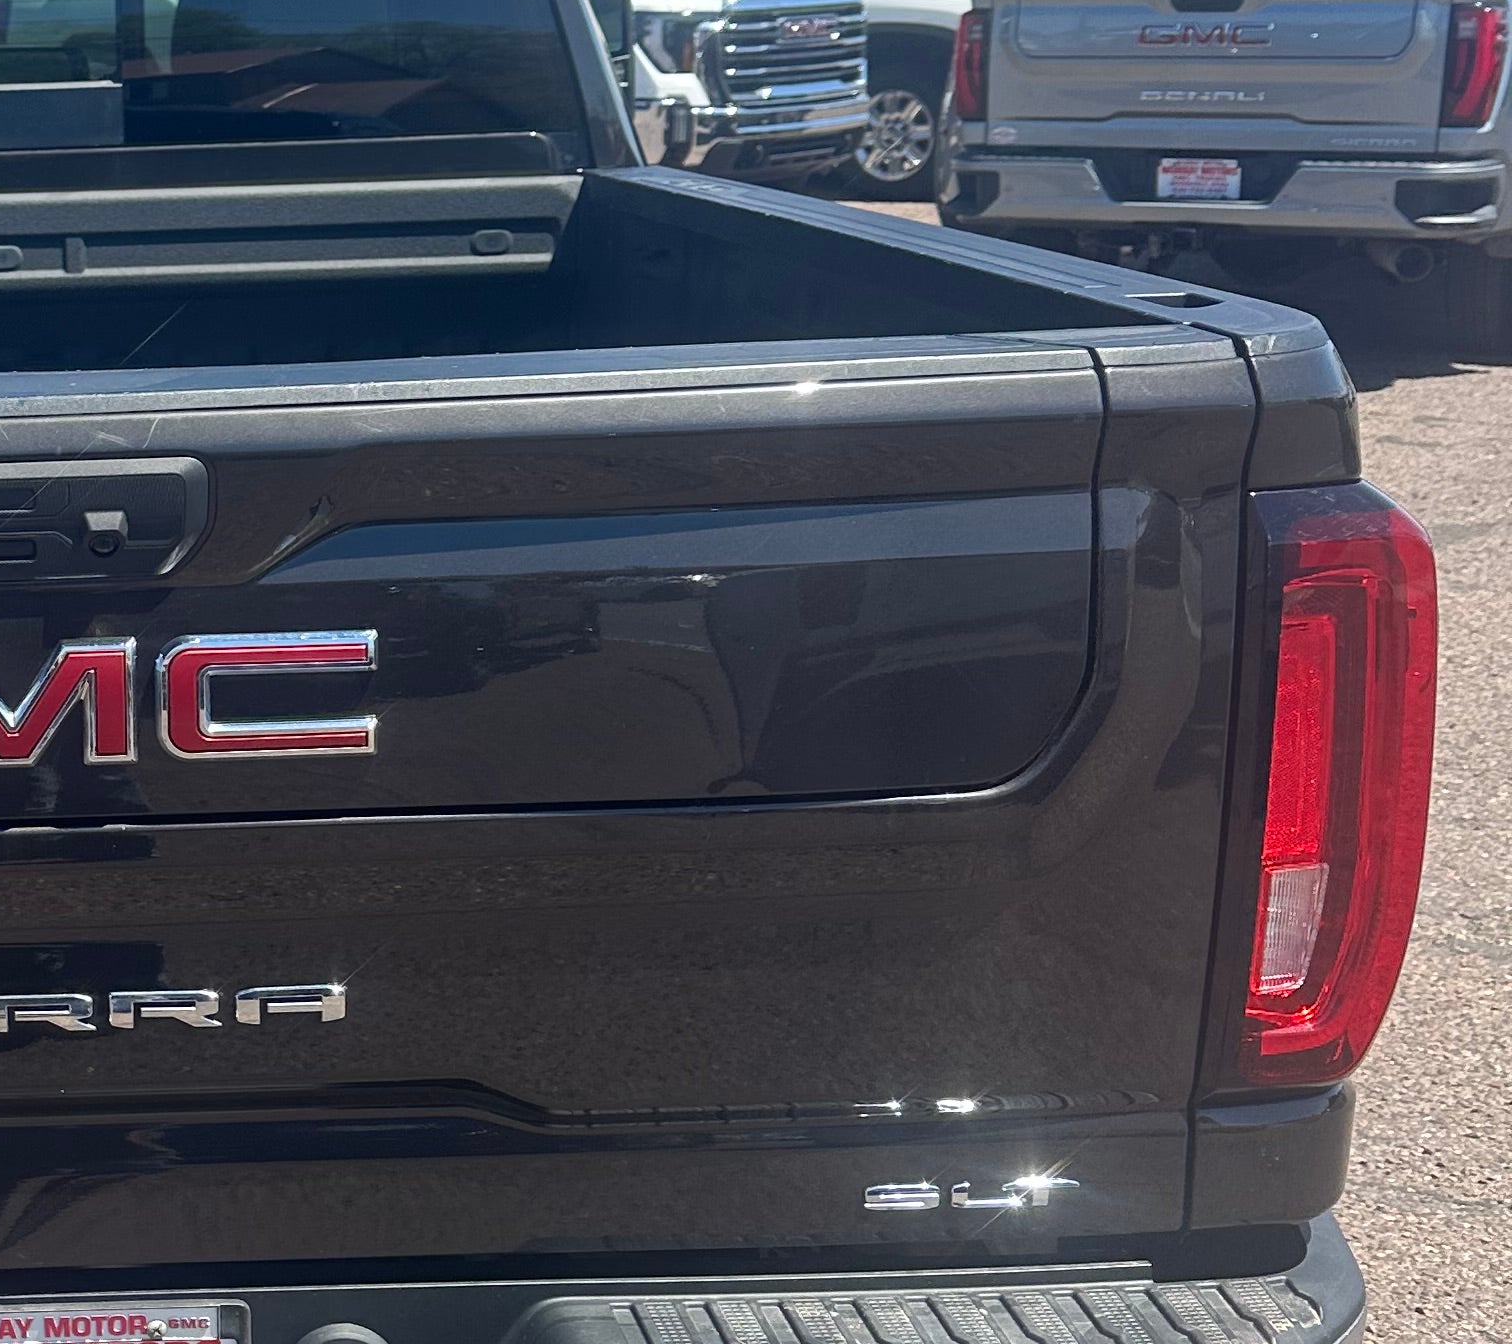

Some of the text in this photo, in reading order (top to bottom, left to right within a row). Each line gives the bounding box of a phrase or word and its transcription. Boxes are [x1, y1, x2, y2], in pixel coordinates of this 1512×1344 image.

[1138, 23, 1275, 47] GMC
[1140, 90, 1265, 102] DENALI
[864, 1176, 1080, 1210] SLT
[44, 1314, 148, 1338] MOTOR
[168, 1316, 211, 1329] GMC
